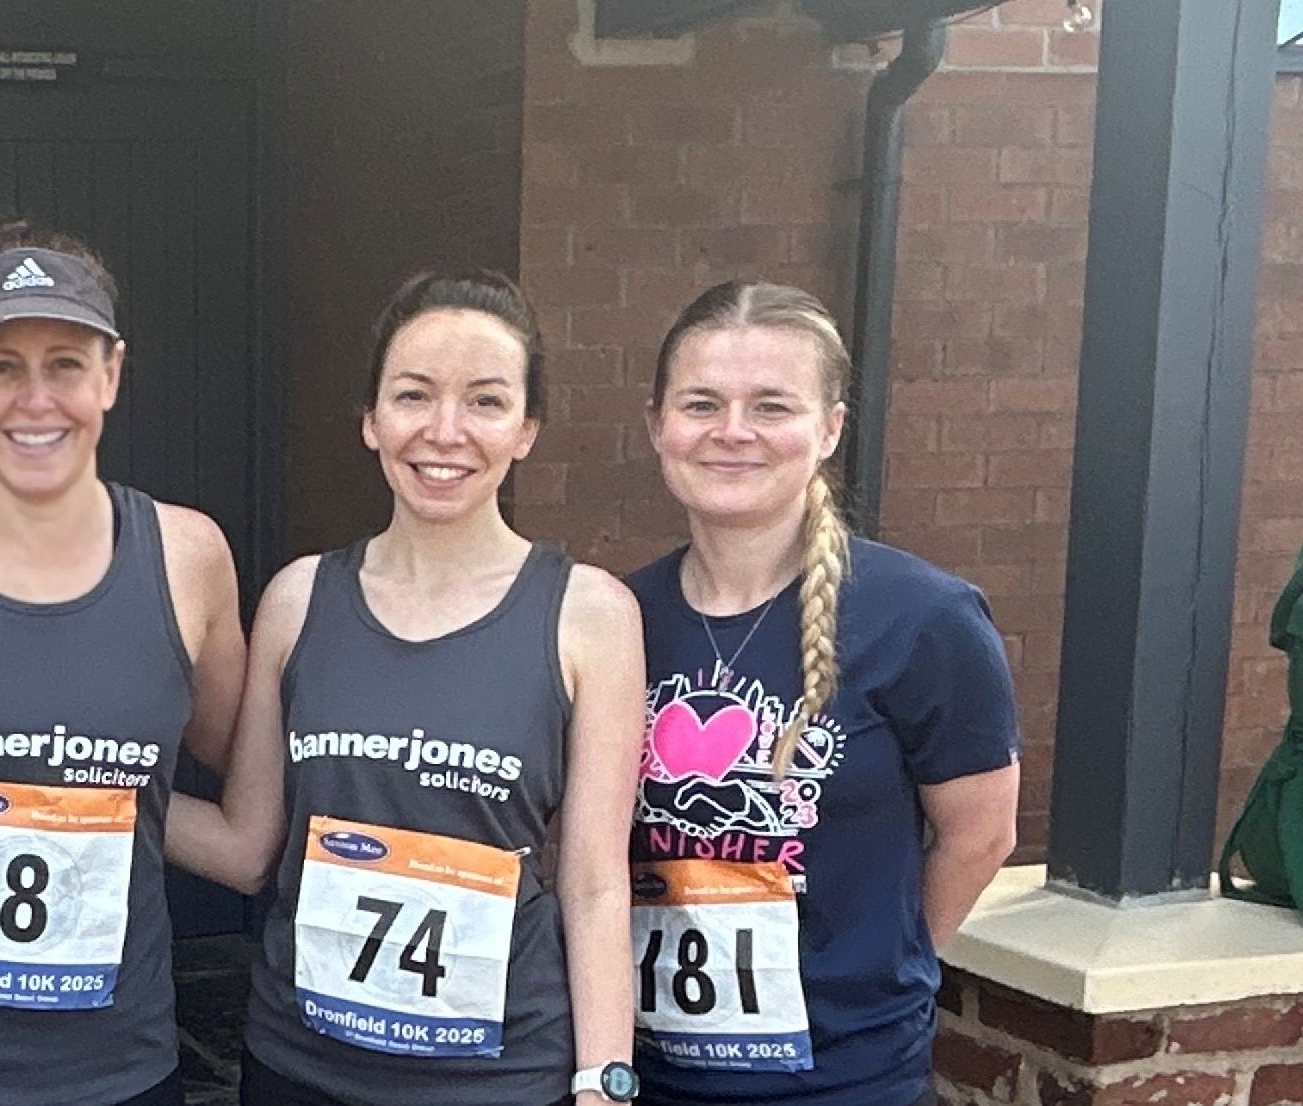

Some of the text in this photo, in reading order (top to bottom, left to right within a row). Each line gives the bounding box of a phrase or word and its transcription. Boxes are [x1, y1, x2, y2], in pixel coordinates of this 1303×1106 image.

[63, 765, 151, 787] solicitors
[288, 729, 523, 781] bannerjones
[419, 770, 510, 803] solicitors
[649, 825, 806, 871] NISHER
[0, 853, 50, 943] 8
[348, 895, 447, 998] 74
[18, 973, 55, 991] 10K
[59, 974, 105, 992] 2025
[305, 999, 387, 1035] Dronfield
[390, 1022, 429, 1042] 10K
[435, 1027, 486, 1044] 2025
[705, 1043, 743, 1058] 10K
[747, 1043, 797, 1058] 2025
